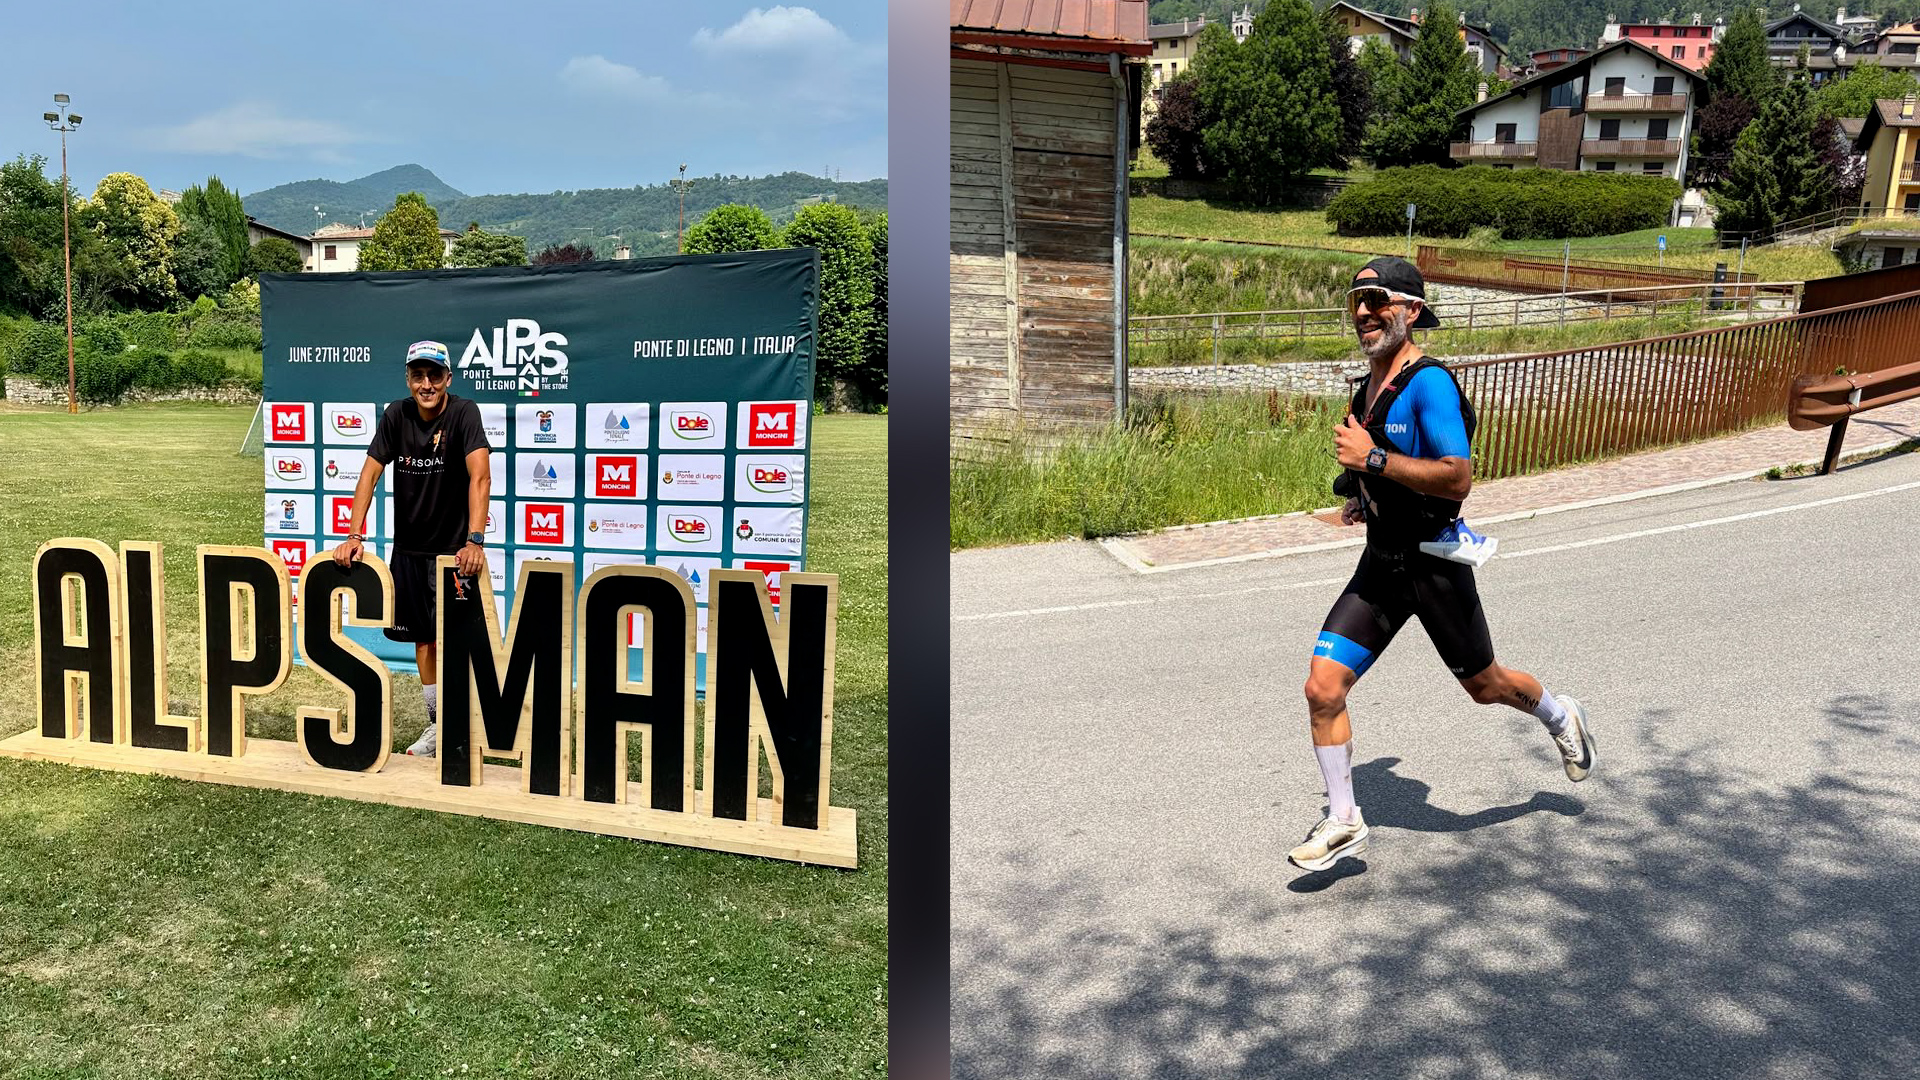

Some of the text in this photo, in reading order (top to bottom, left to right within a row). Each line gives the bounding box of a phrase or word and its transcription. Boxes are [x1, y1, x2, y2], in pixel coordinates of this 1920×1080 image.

[457, 318, 569, 376] ALPS
[633, 340, 673, 358] PONTE
[676, 339, 689, 357] DI
[693, 338, 734, 356] LEGNO
[753, 335, 796, 355] ITALIA
[288, 346, 371, 363] JUNE 27TH 2026
[463, 370, 491, 379] PONTE
[475, 380, 516, 390] DI LEGNO
[337, 415, 362, 427] Dole
[677, 416, 709, 429] Dole
[278, 460, 302, 471] Dole
[754, 469, 787, 482] Dole
[675, 519, 706, 532] Dole
[36, 546, 830, 831] ALPS MAN
